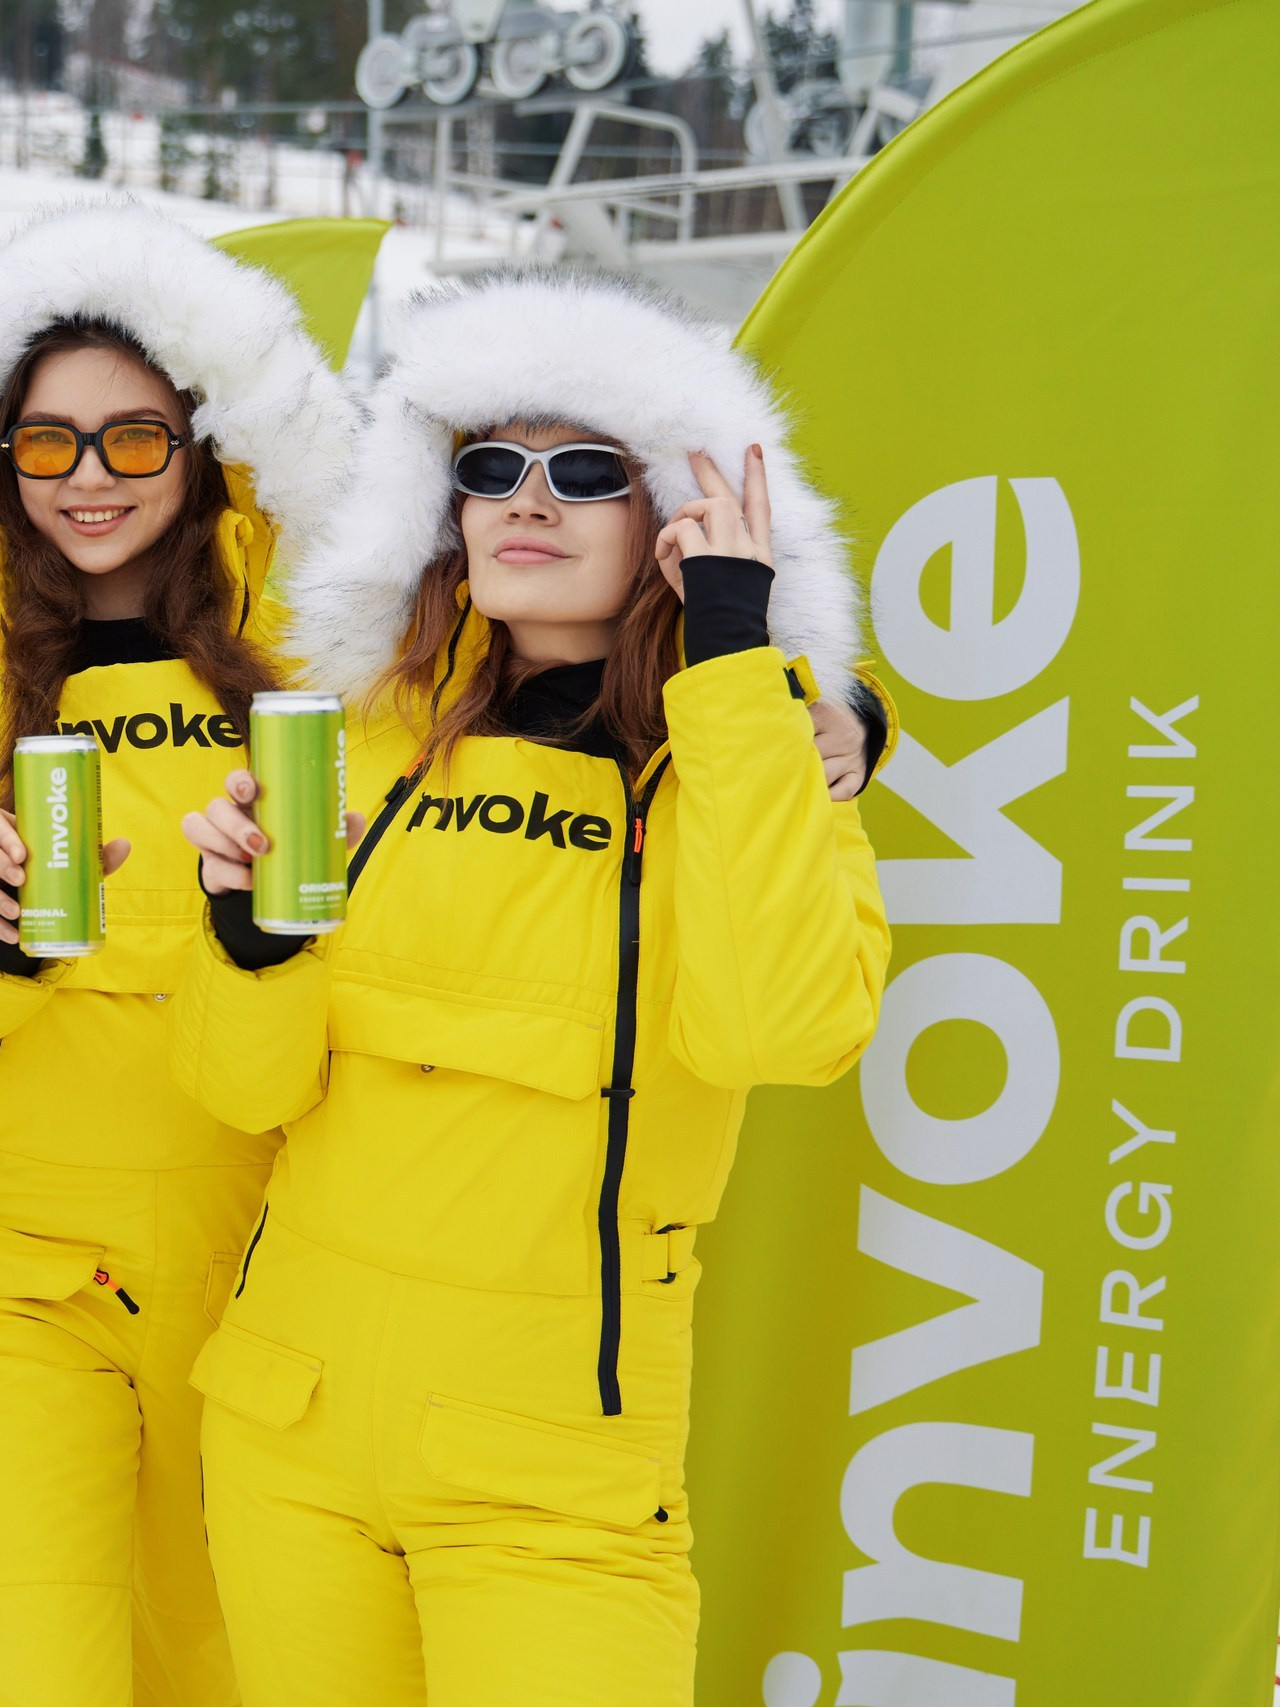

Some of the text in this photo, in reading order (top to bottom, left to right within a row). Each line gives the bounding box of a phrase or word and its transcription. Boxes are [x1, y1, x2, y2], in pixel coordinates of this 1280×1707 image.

[46, 766, 70, 870] invoke
[404, 790, 613, 852] nvoke
[761, 474, 1083, 1707] invoke
[1082, 694, 1200, 1568] ENERGY DRINK
